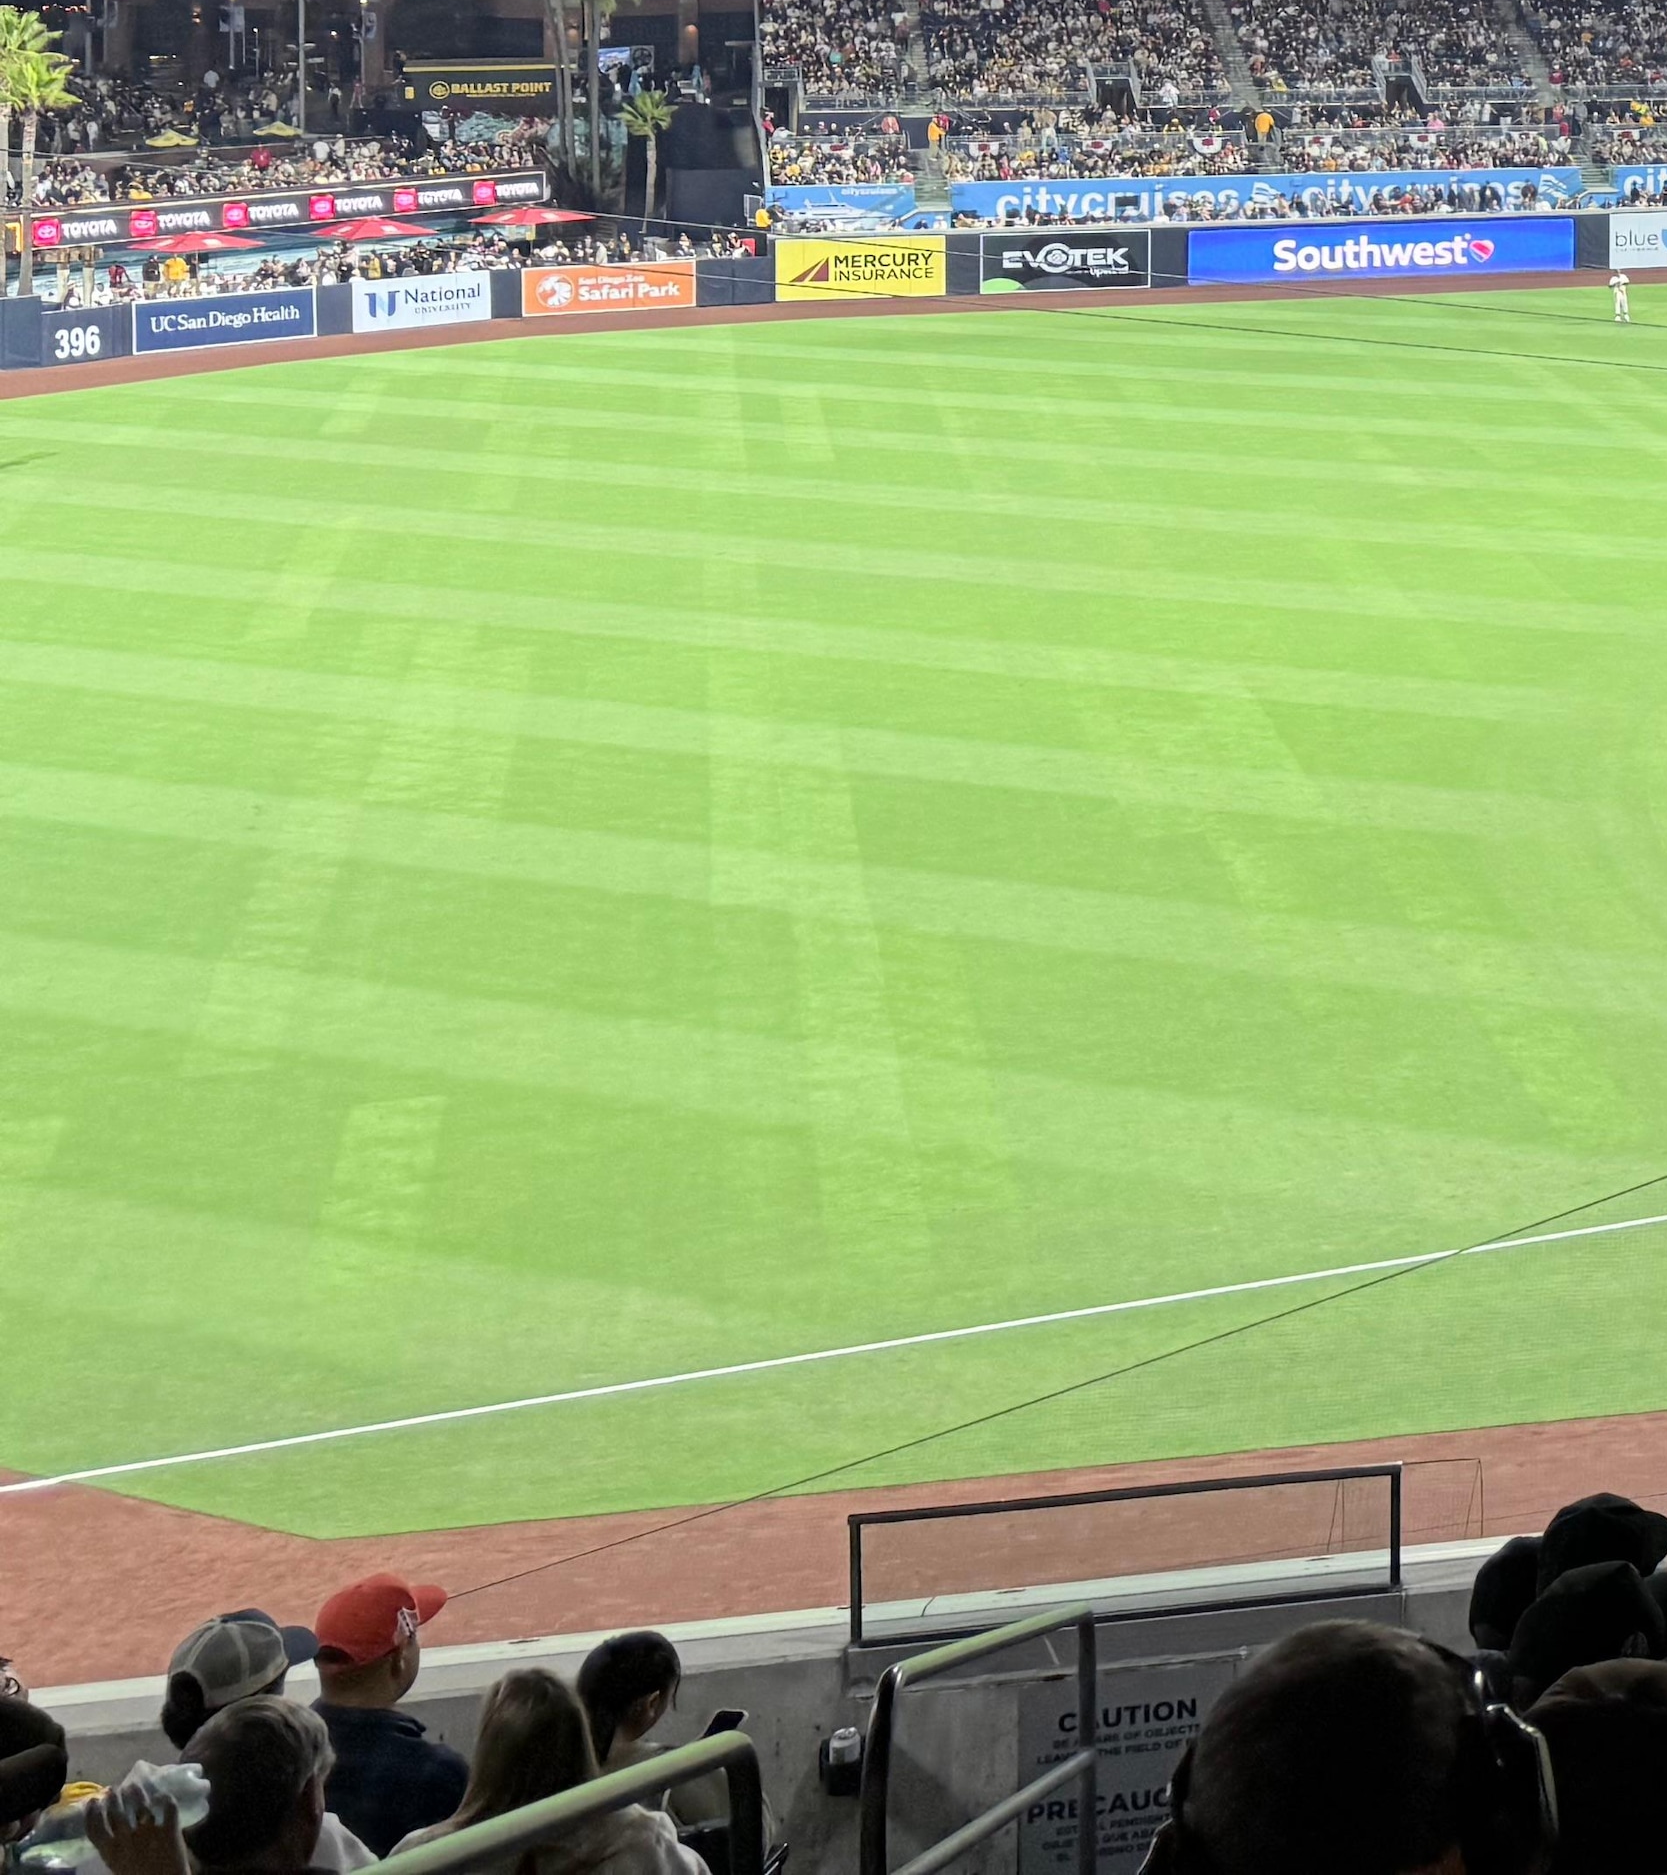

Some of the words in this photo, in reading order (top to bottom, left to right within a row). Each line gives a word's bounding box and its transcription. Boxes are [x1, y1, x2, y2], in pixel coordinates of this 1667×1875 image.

[451, 82, 509, 94] BALLAST
[512, 81, 552, 93] POINT
[249, 203, 299, 219] TOYOTA
[335, 195, 383, 212] TOYOTA
[62, 219, 117, 238] TOYOTA
[158, 211, 210, 228] TOYOTA
[1615, 229, 1658, 247] blue
[834, 252, 933, 269] MERCURY
[1273, 234, 1468, 271] Southwest
[834, 267, 934, 282] INSURANCE
[404, 283, 481, 305] National
[578, 284, 633, 301] Safari
[637, 282, 680, 298] Park
[151, 315, 176, 333] UC
[177, 313, 207, 331] San
[209, 310, 251, 329] Diego
[252, 304, 300, 323] Health
[54, 325, 100, 360] 396
[1059, 1698, 1197, 1733] CUTION
